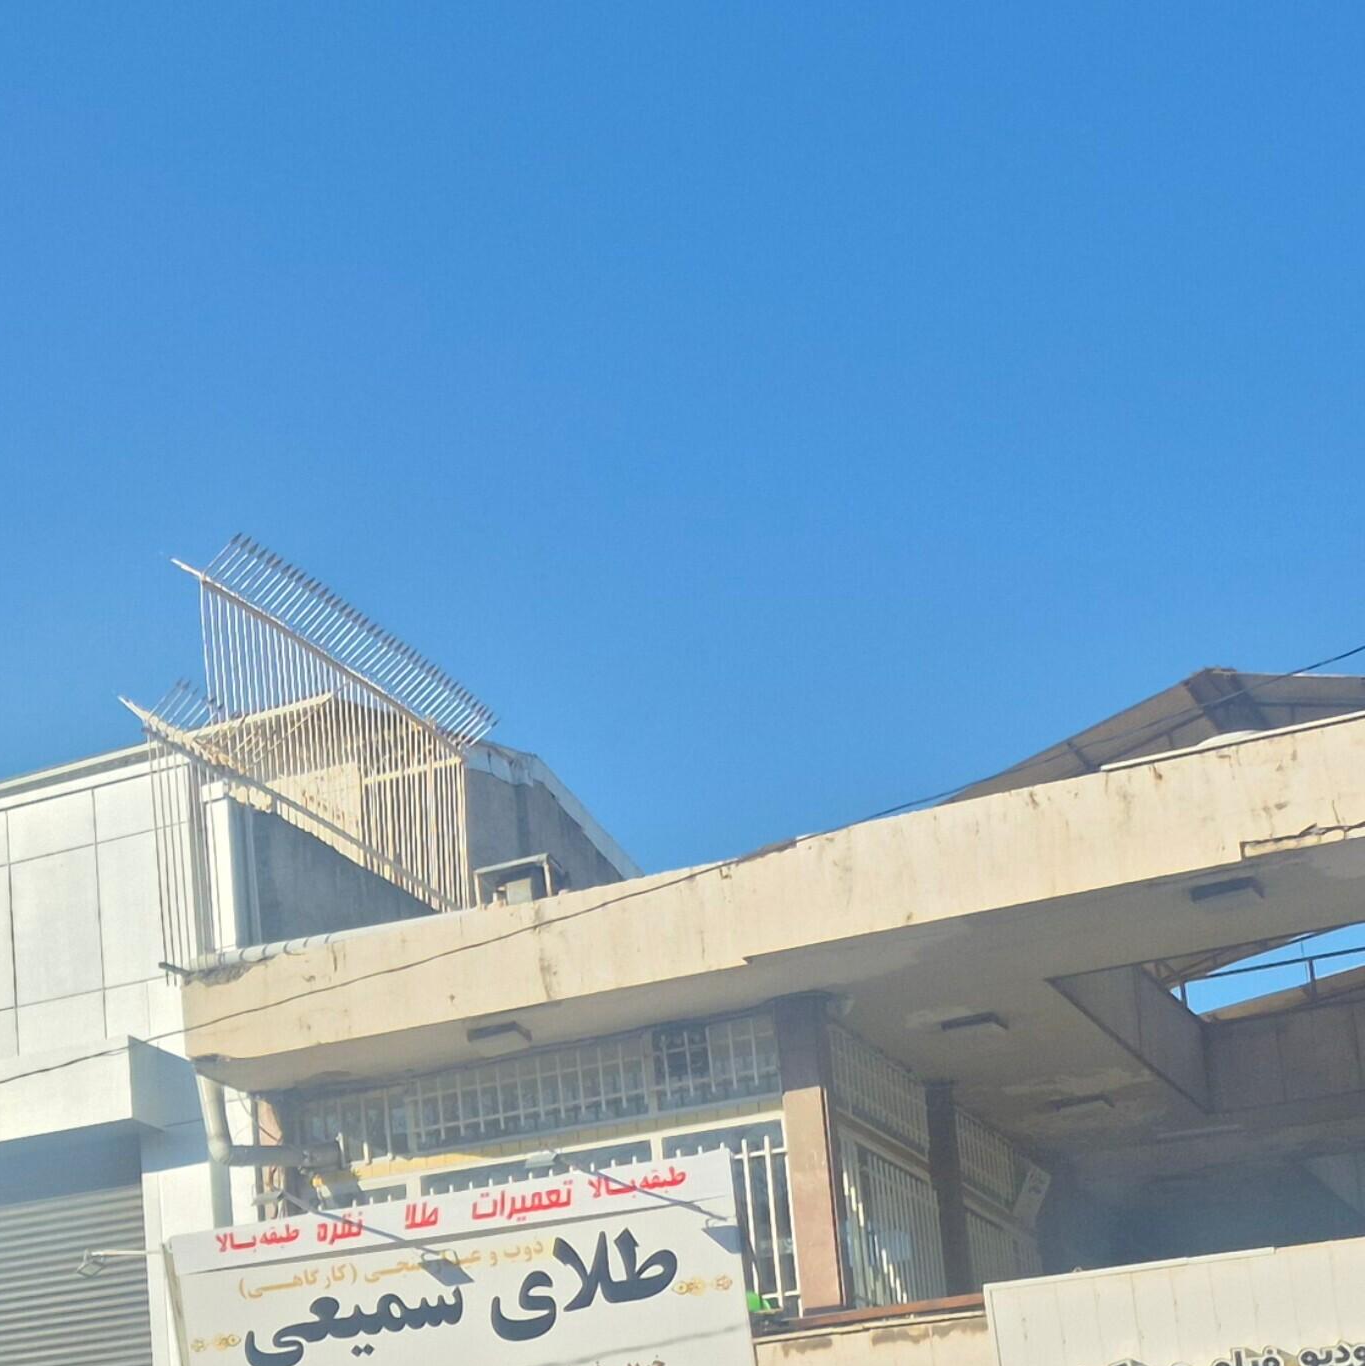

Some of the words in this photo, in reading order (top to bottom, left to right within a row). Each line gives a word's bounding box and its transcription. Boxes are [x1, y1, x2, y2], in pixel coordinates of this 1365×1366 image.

[404, 1201, 440, 1230] طلا
[471, 1179, 574, 1222] تعمیرات
[316, 1211, 364, 1246] نقره
[490, 1226, 678, 1341] طلای
